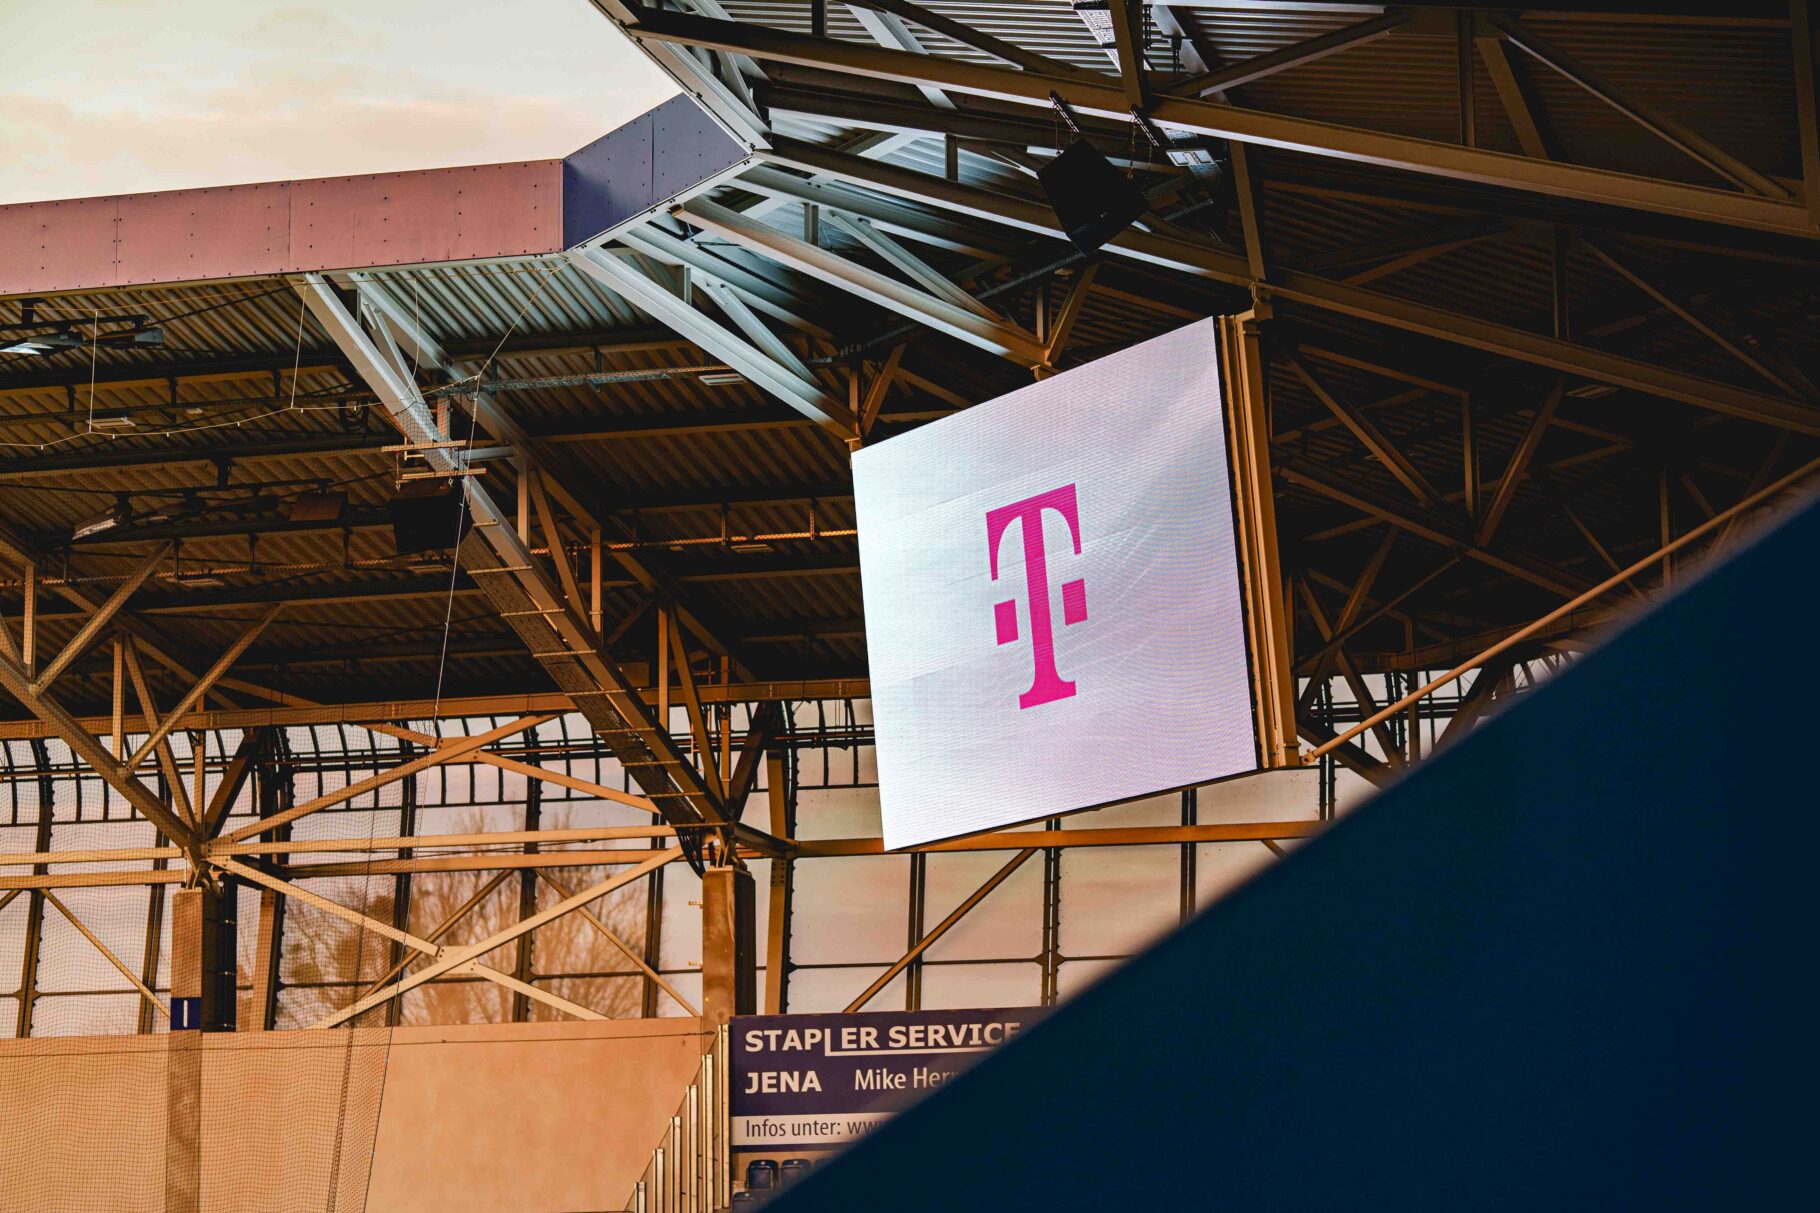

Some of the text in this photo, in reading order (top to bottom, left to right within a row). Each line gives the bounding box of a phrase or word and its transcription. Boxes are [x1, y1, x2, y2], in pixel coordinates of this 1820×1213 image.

[986, 483, 1087, 710] T
[745, 1026, 880, 1056] STAPLER
[744, 1070, 822, 1094] JENA
[854, 1068, 906, 1091] Mike
[745, 1119, 882, 1137] Infos unter: ww
